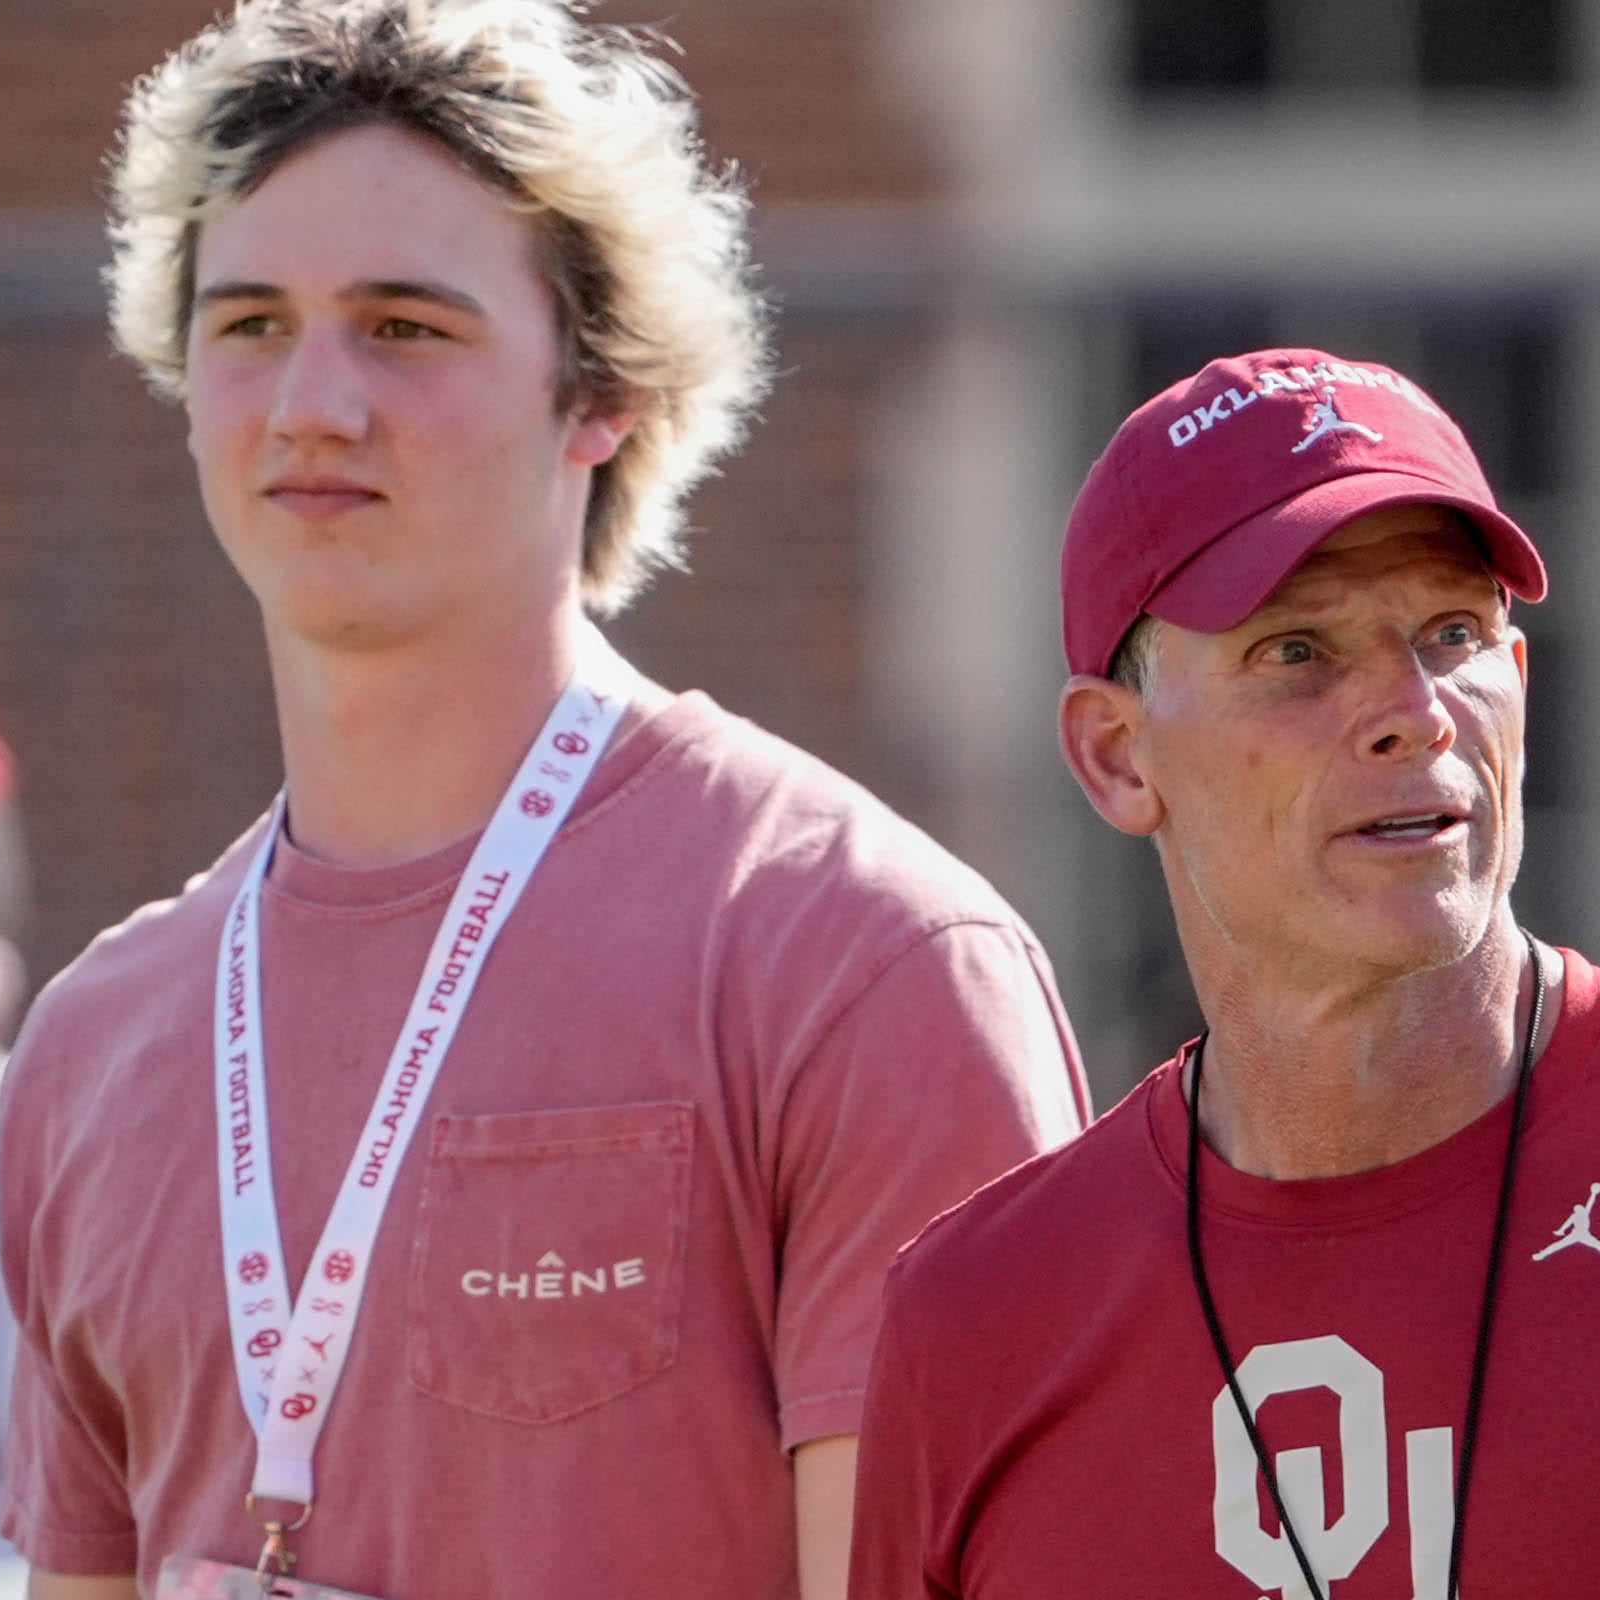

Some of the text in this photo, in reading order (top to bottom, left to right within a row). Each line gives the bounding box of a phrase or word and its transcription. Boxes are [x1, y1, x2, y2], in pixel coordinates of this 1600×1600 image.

[359, 868, 511, 1190] OKLAHOMA FOOTBALL
[227, 1053, 257, 1198] FOOTBALL
[460, 1250, 647, 1299] CHÊNE
